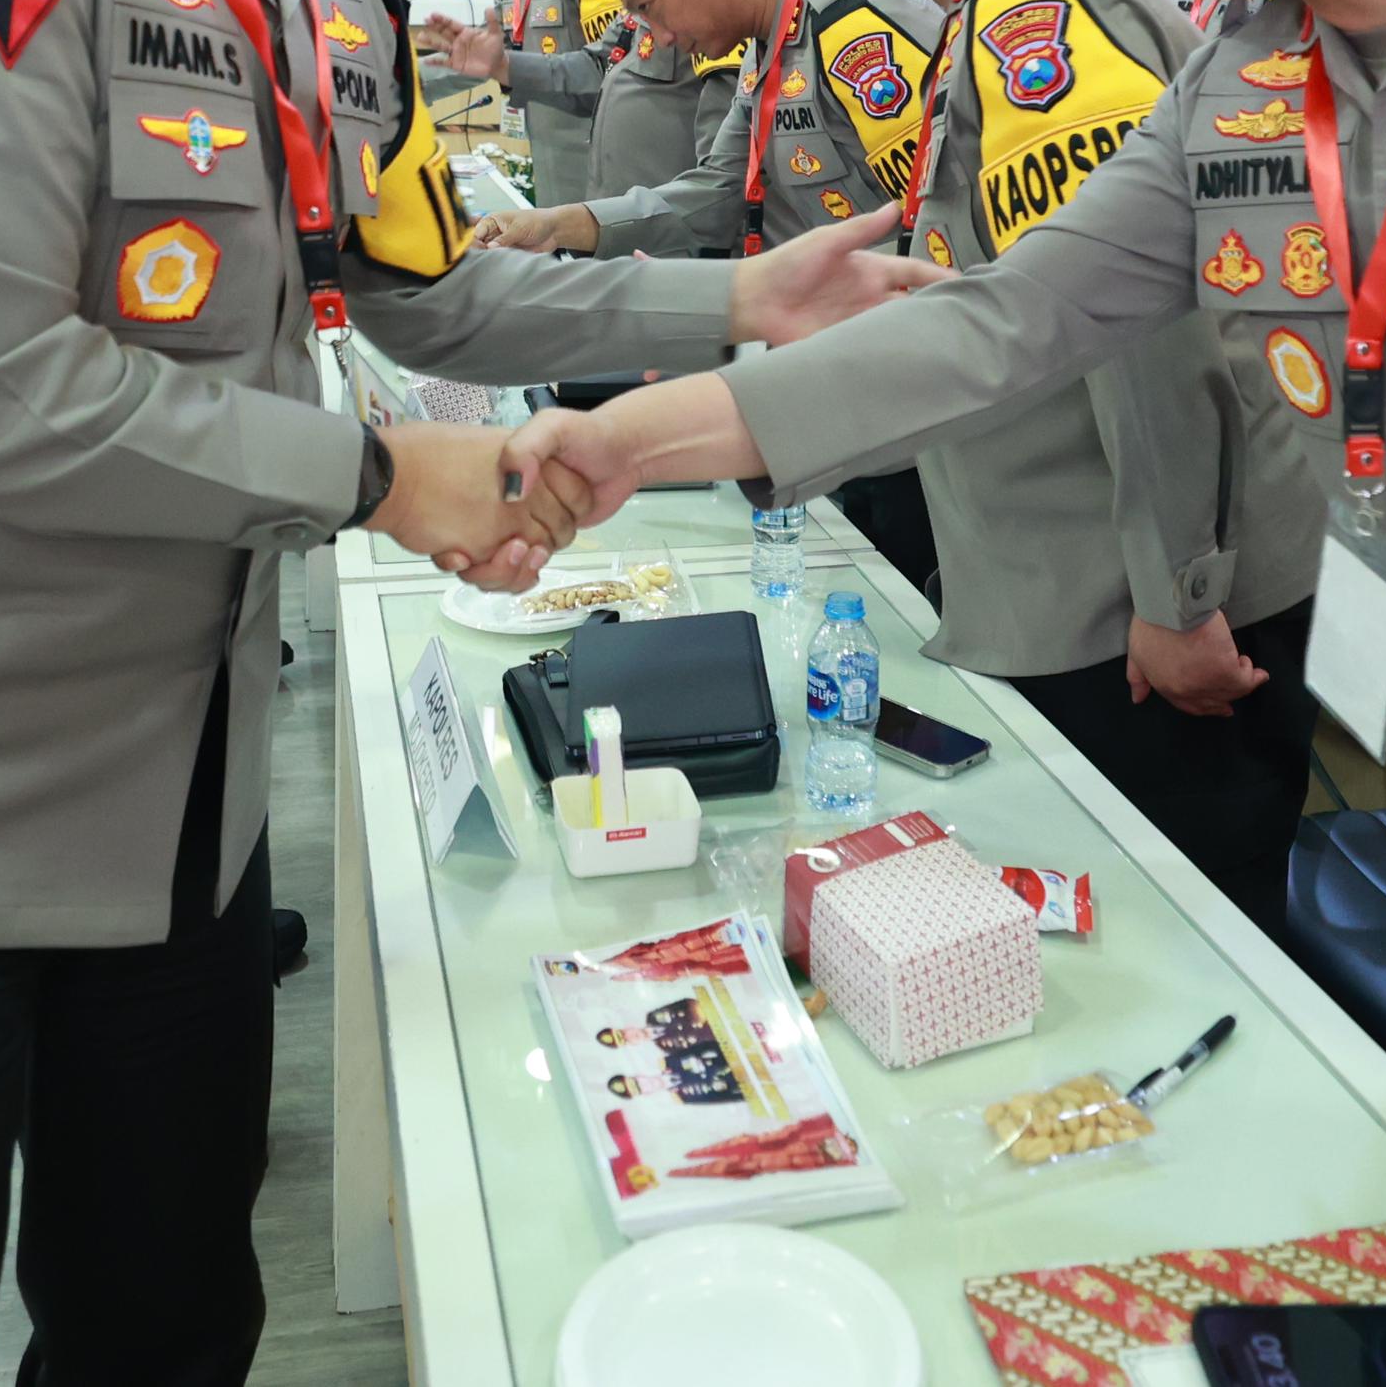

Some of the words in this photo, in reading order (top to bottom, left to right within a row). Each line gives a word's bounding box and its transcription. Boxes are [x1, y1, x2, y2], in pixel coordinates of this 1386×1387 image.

[129, 18, 242, 86] IMAM.S
[838, 39, 881, 70] POLRES
[775, 107, 816, 132] POLRI
[987, 116, 1150, 238] KAOPSR
[818, 688, 838, 706] Life
[423, 671, 459, 782] KAPOLRES
